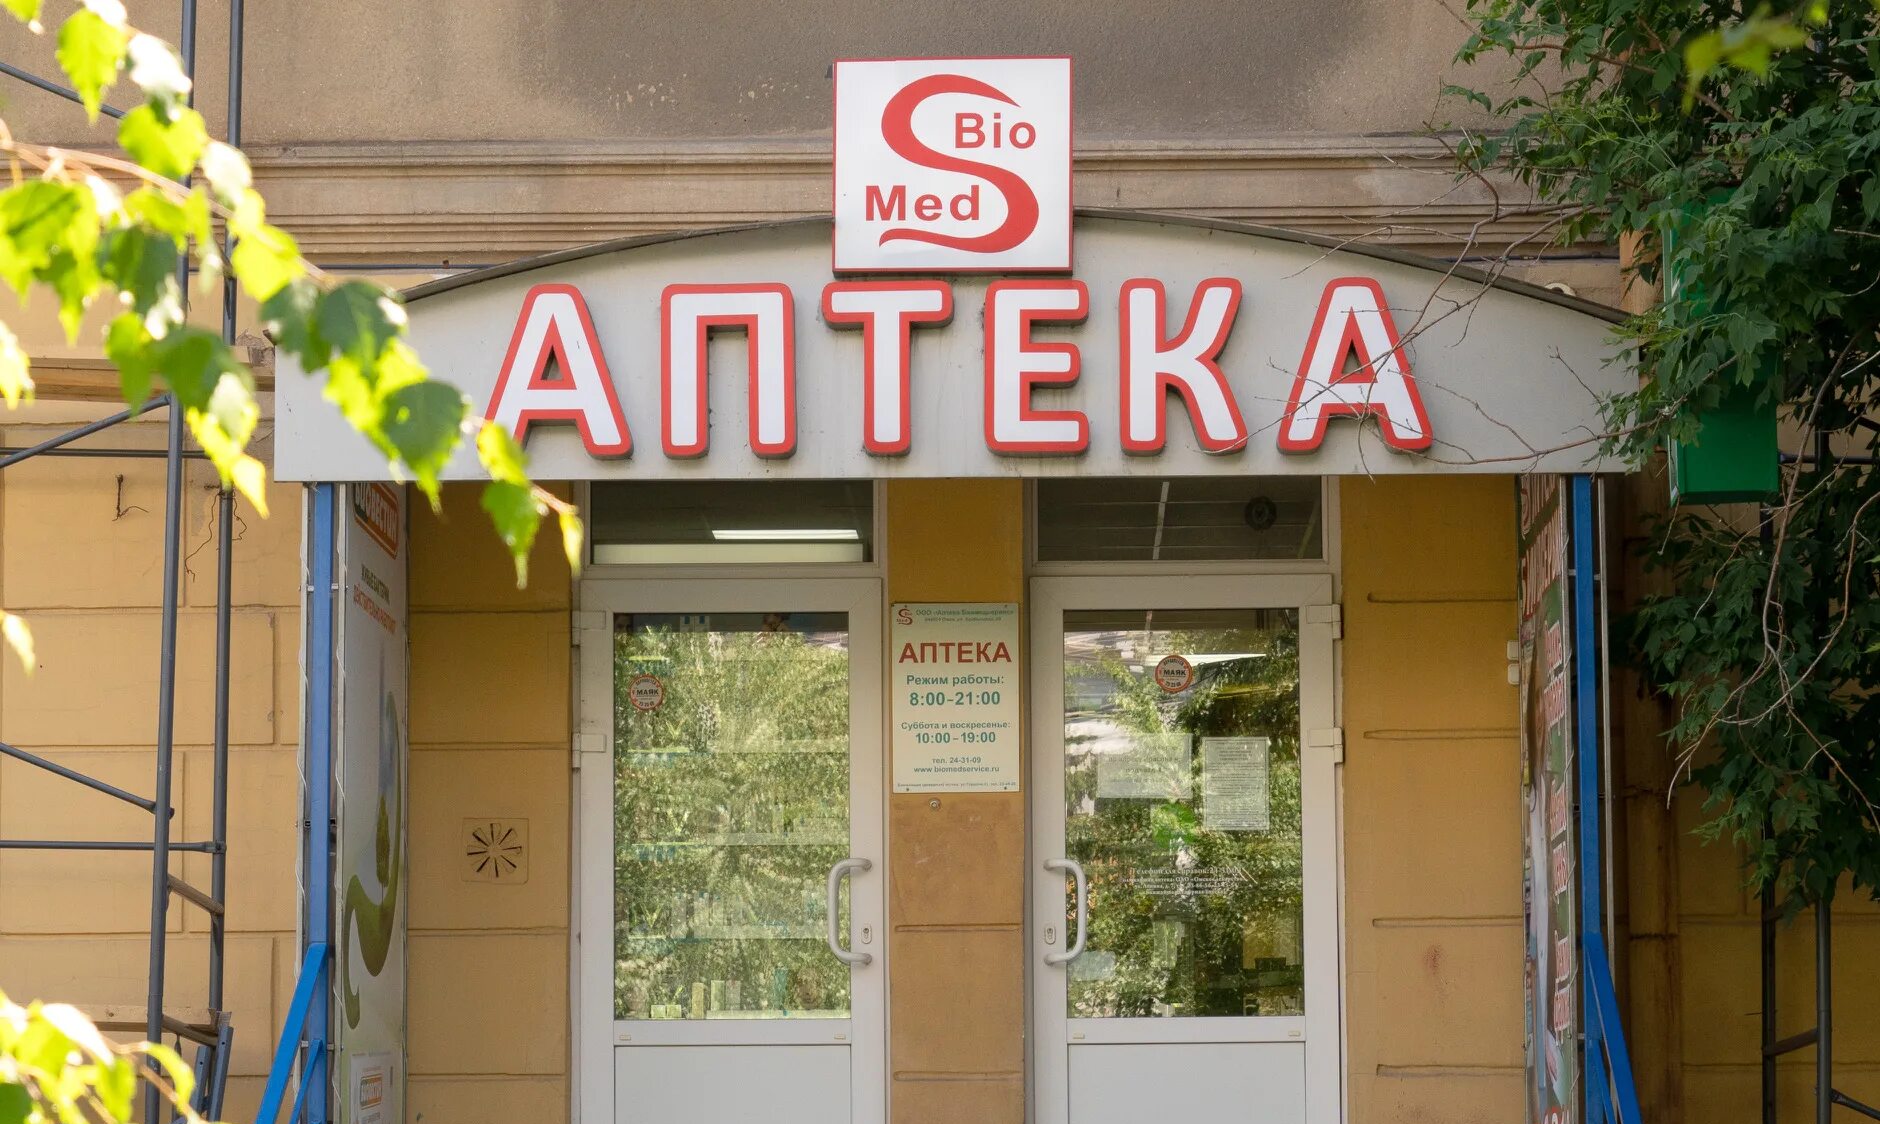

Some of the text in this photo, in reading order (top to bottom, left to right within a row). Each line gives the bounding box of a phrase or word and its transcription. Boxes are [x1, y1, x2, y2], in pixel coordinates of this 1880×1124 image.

[955, 112, 1036, 149] Bio
[866, 185, 979, 221] Med
[480, 276, 1434, 459] АПТЕКА
[899, 642, 1012, 663] АПТЕКА
[906, 674, 1004, 687] Режим работы:
[901, 722, 940, 731] Суббота
[950, 721, 1011, 730] воскресенье:
[950, 756, 982, 764] 24-31-09
